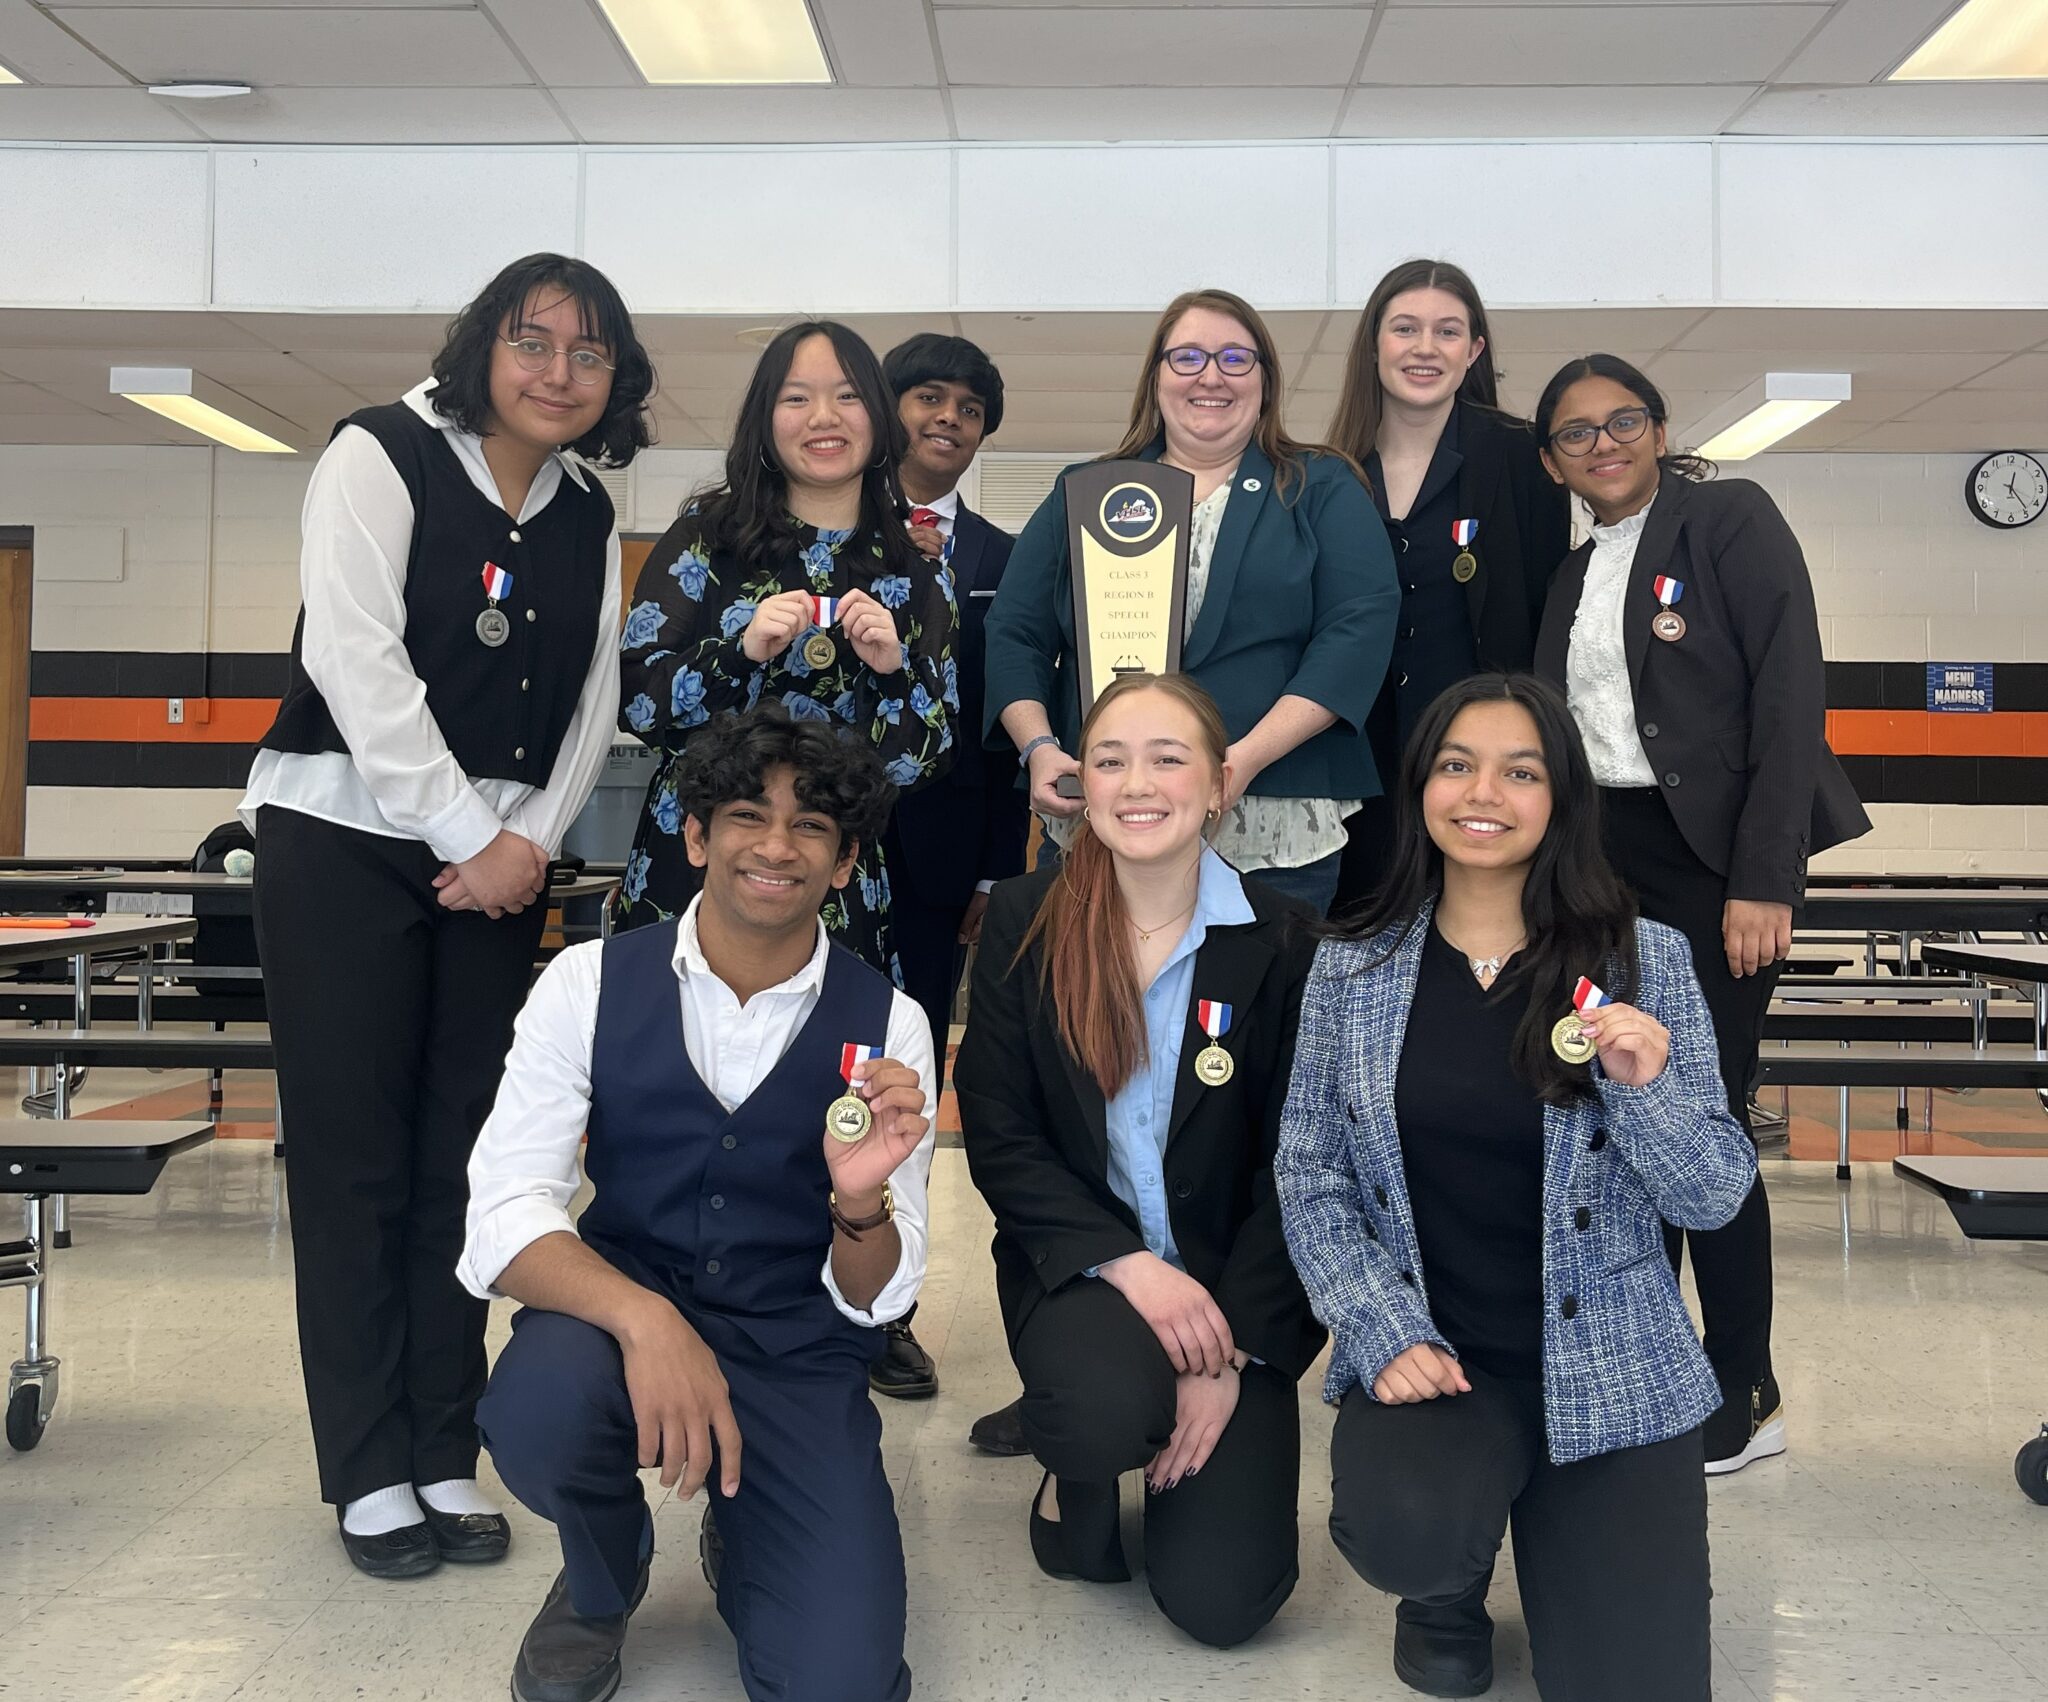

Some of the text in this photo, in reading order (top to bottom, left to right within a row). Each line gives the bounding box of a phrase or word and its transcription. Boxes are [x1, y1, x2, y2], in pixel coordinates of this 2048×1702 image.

[1992, 460, 1998, 468] 11
[2007, 456, 2015, 464] 12
[2034, 470, 2040, 478] 2
[1977, 484, 1984, 492] 9
[2038, 485, 2044, 494] 3
[1994, 510, 1998, 518] 7
[2008, 514, 2014, 522] 6
[2024, 510, 2029, 518] 5
[1109, 570, 1141, 580] CLASS
[1104, 591, 1154, 600] REGION B
[1108, 610, 1149, 620] SPEECH
[1100, 631, 1157, 640] CHAMPION
[1945, 671, 1974, 687] MENU
[1934, 689, 1985, 705] MADNESS
